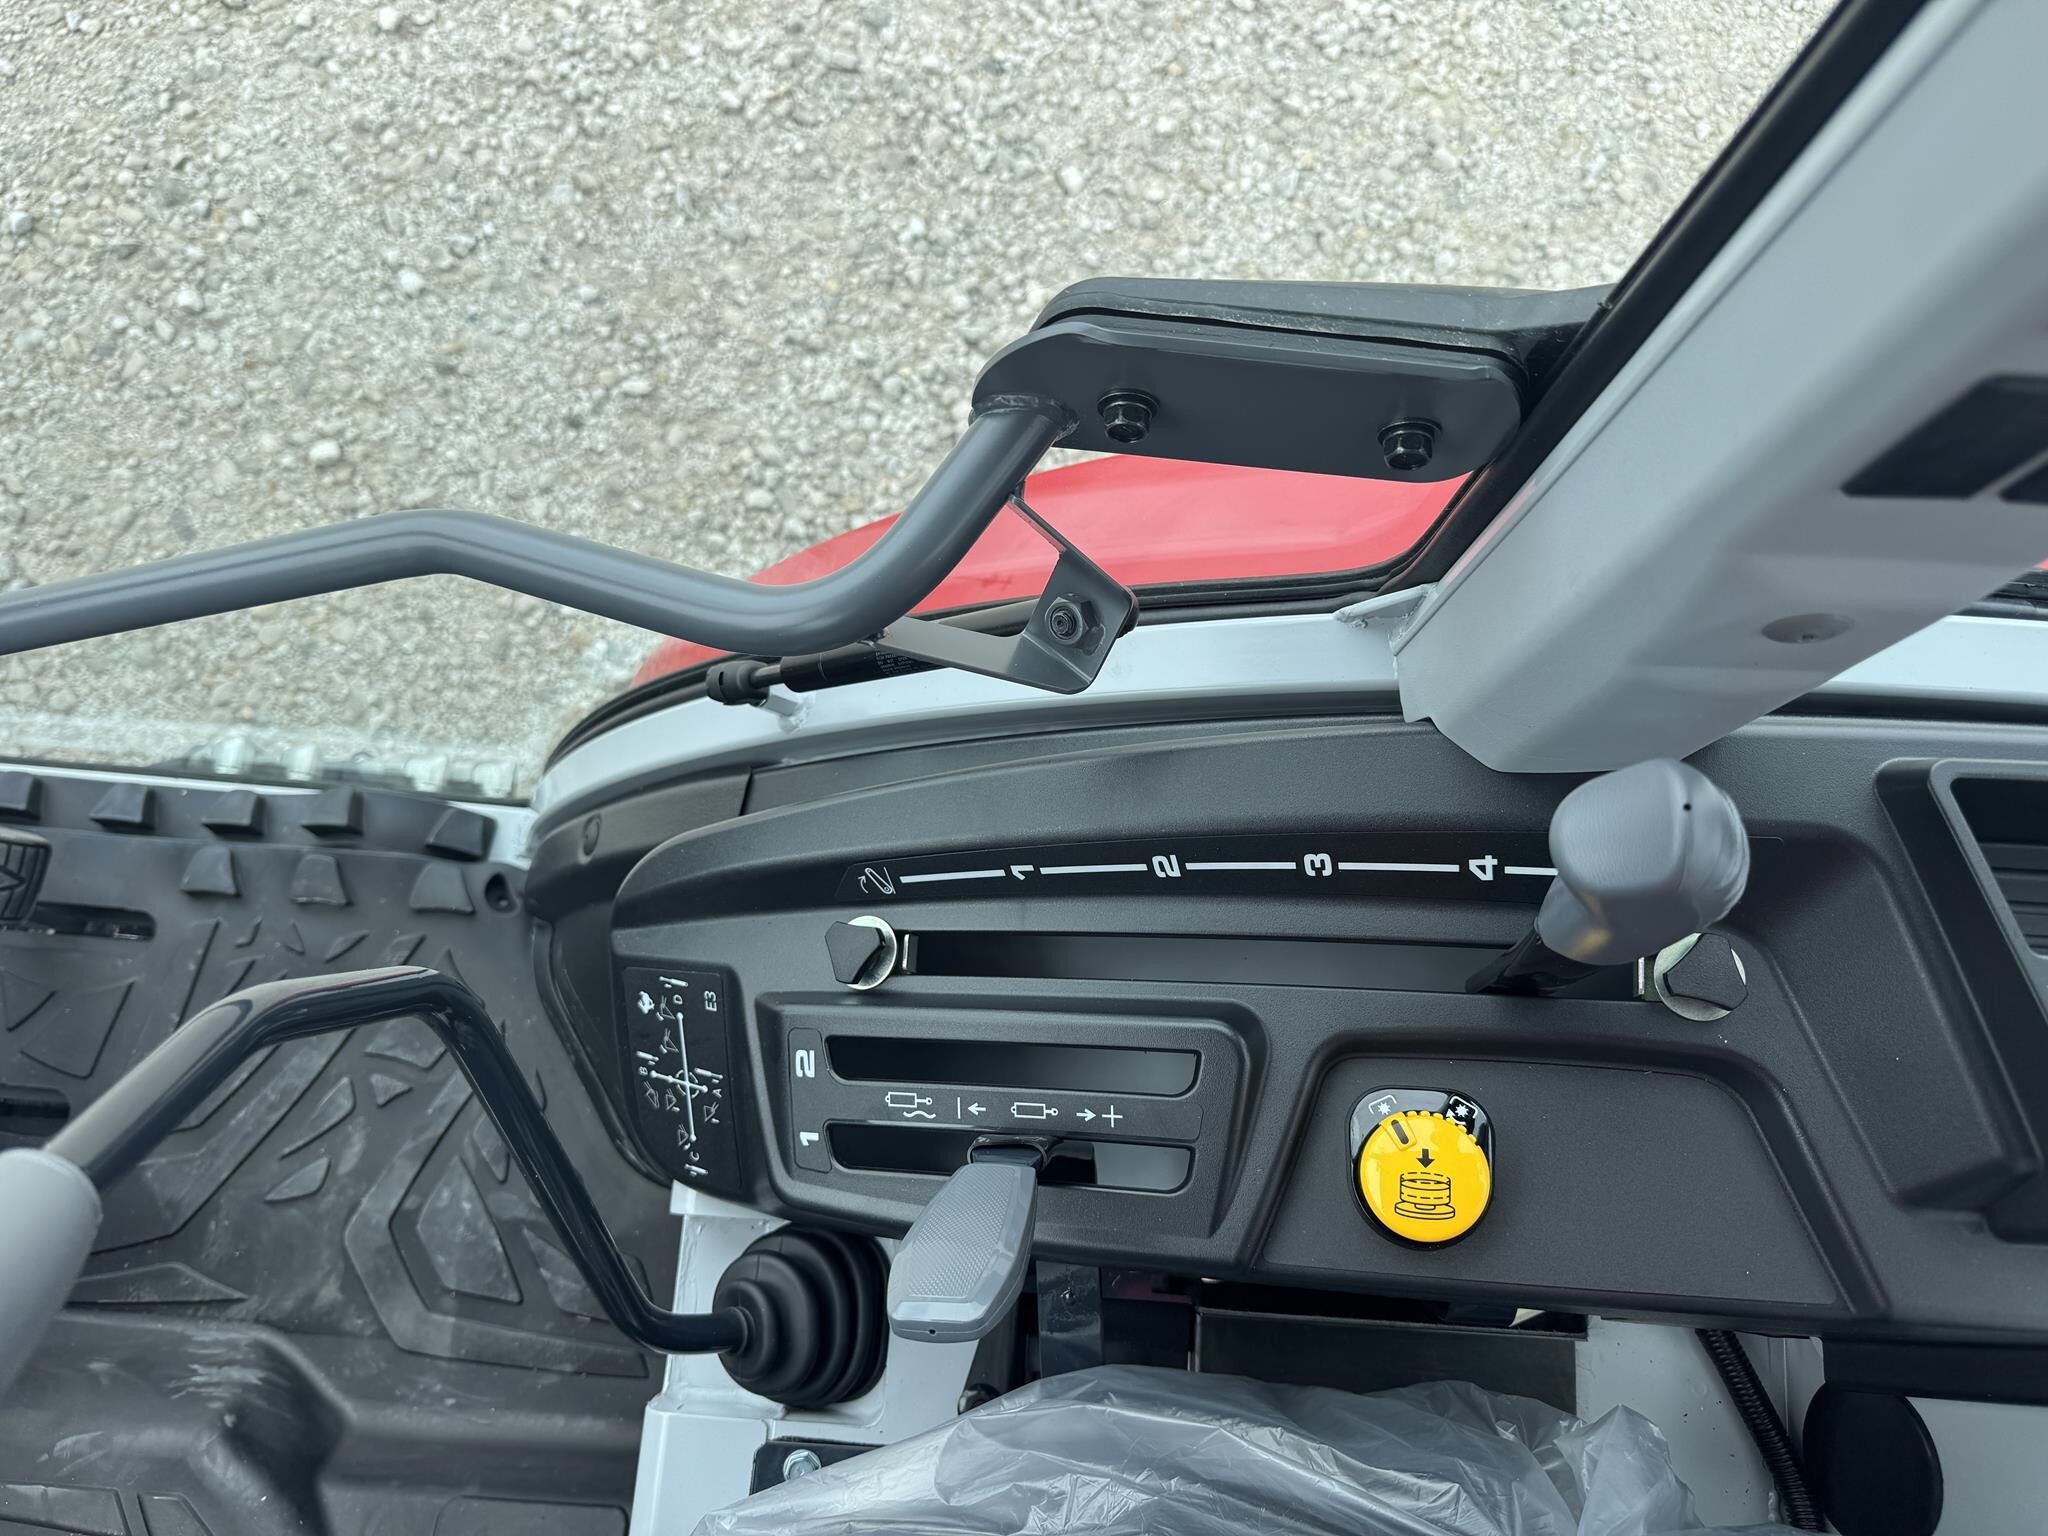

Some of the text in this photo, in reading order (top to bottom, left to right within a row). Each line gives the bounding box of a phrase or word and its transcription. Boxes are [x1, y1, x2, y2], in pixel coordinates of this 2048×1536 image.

[1010, 865, 1035, 881] 1
[1151, 854, 1182, 878] 2
[1303, 853, 1333, 877] 3
[1468, 855, 1498, 881] 4
[673, 994, 683, 1005] D
[704, 990, 718, 1012] E3
[639, 1066, 648, 1076] B
[795, 1049, 815, 1078] 2
[713, 1088, 722, 1098] A
[799, 1131, 819, 1146] 1
[690, 1151, 700, 1161] C
